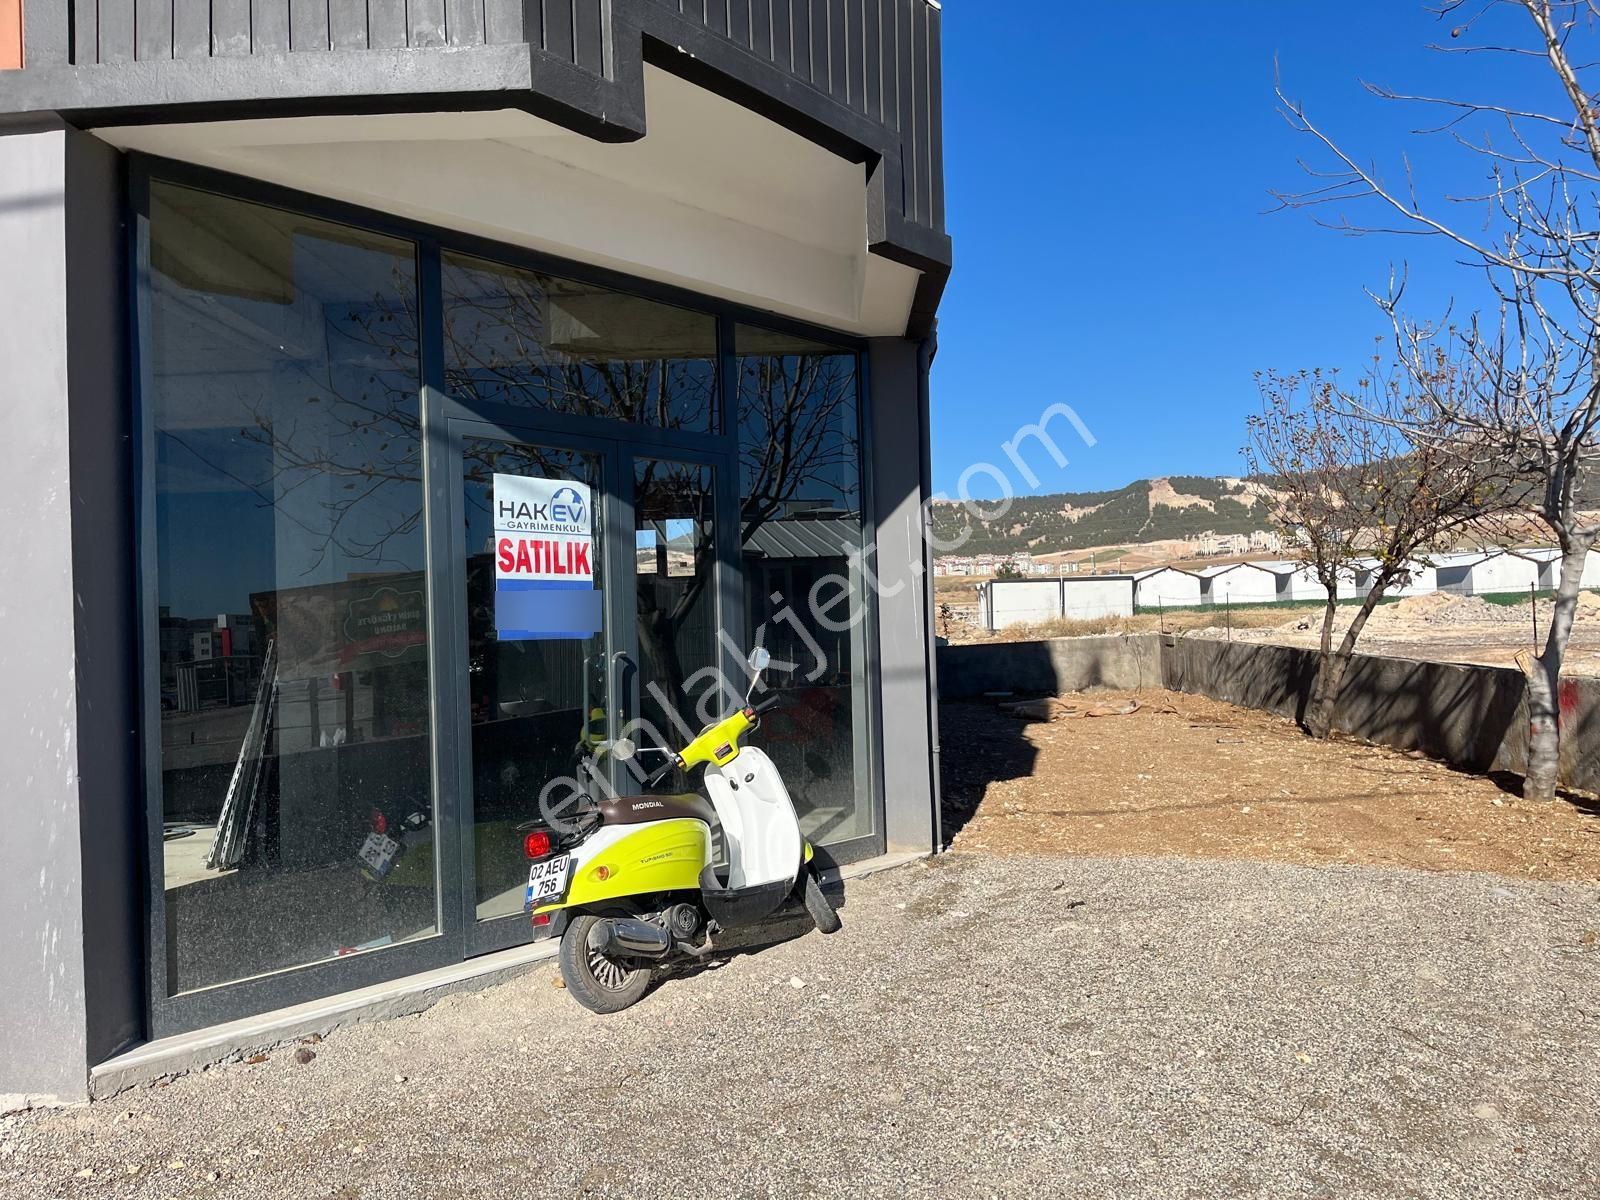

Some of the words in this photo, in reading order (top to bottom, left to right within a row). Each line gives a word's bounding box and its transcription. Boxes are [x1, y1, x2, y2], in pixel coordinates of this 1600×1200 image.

[498, 537, 591, 575] SATILIK
[632, 801, 664, 811] MONDIAL
[531, 864, 545, 881] 02
[545, 856, 568, 877] AEU
[538, 877, 557, 897] 756
